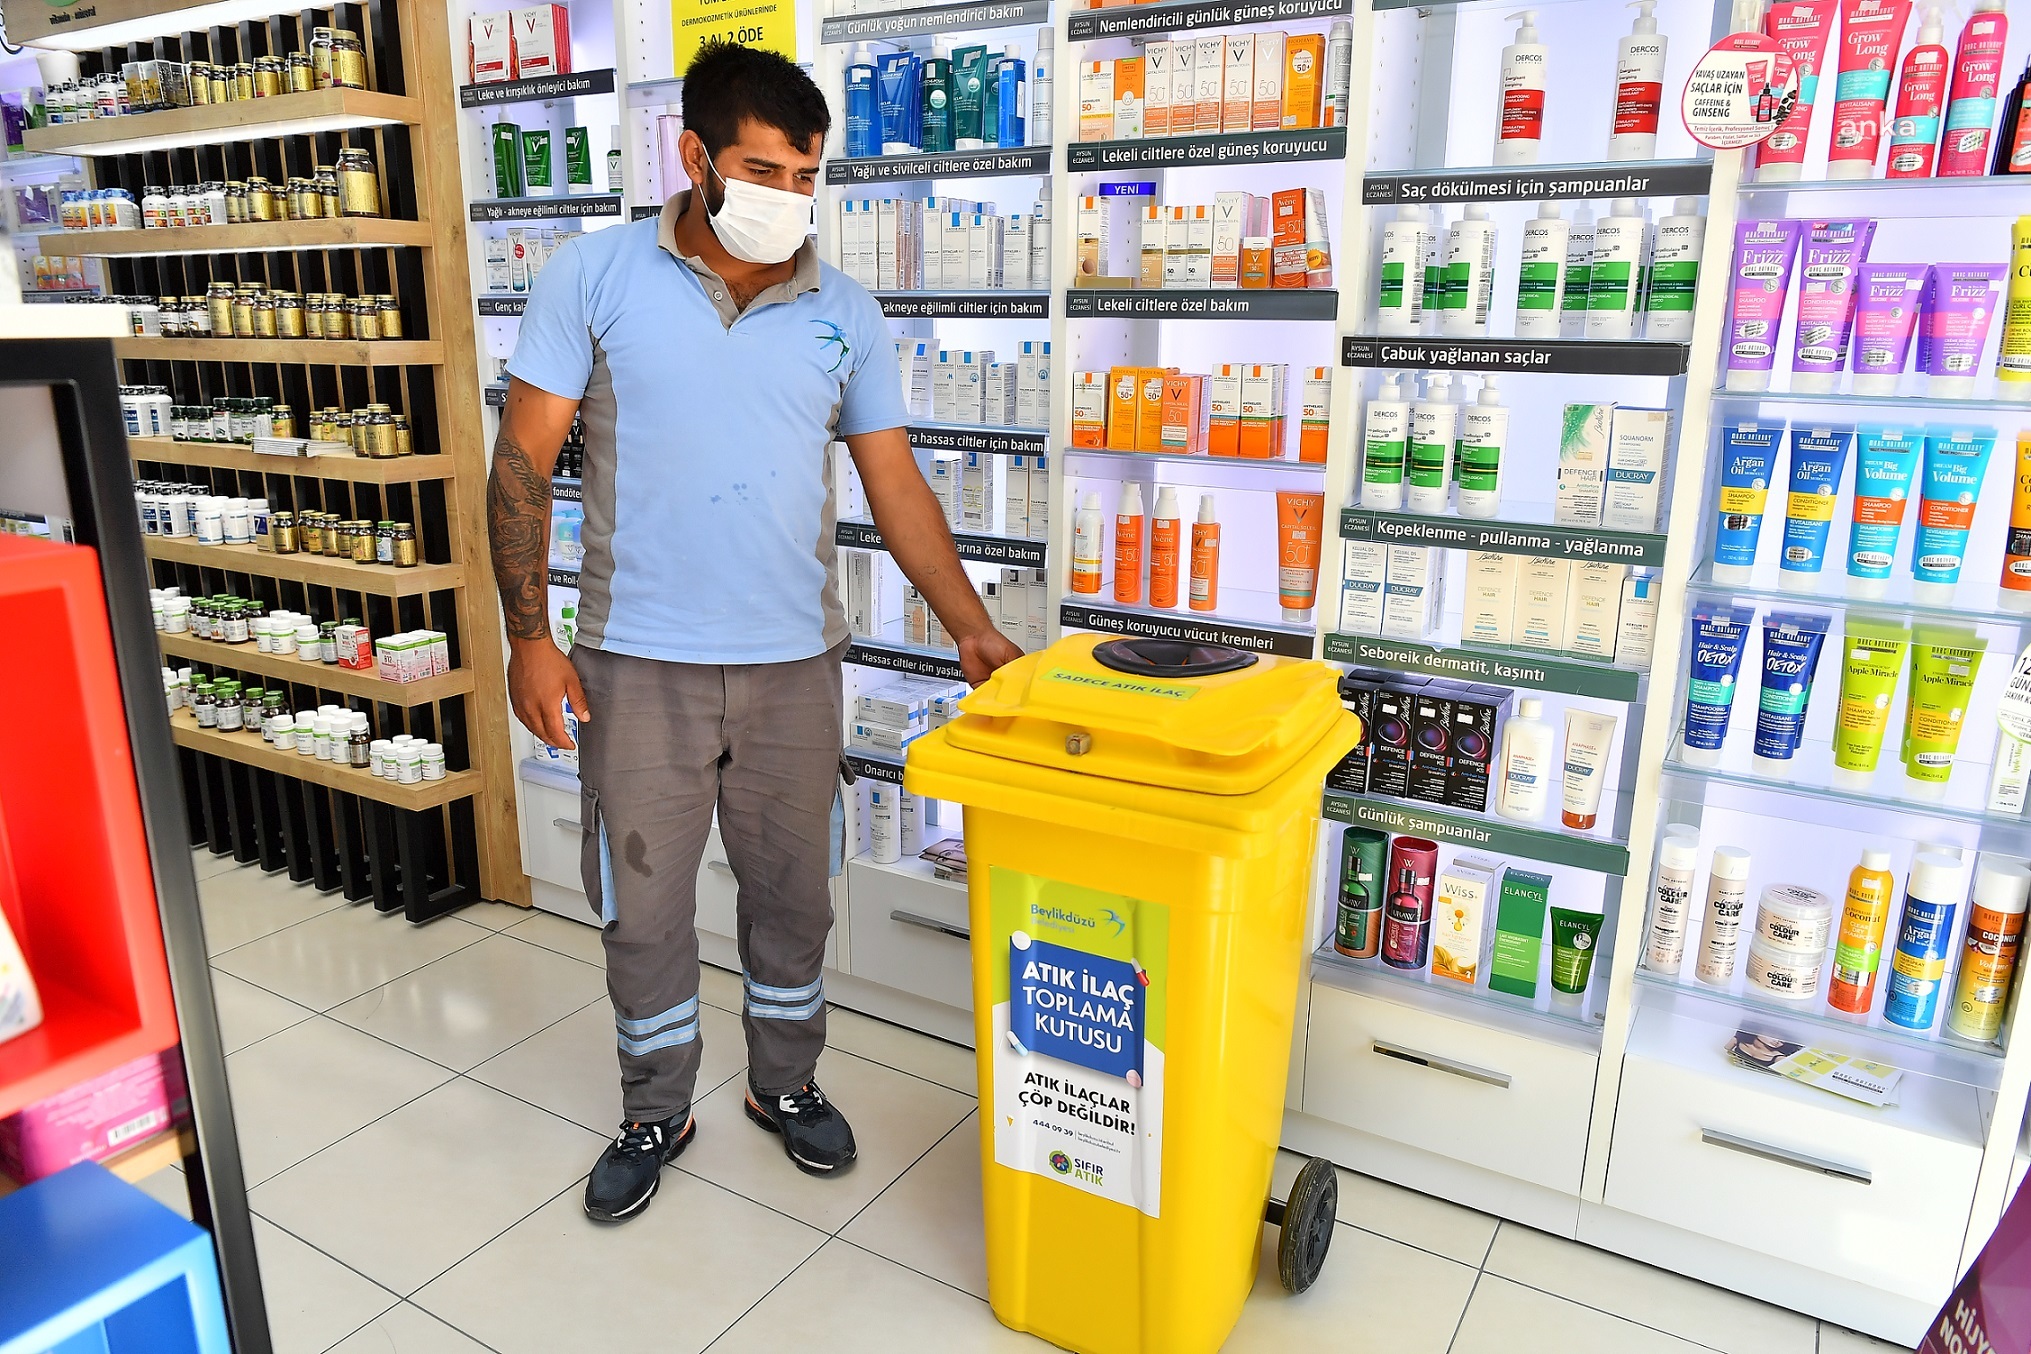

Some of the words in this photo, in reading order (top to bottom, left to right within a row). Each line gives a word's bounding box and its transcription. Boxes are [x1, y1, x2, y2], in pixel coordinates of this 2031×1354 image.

[682, 12, 733, 26] DERMOKOZMETİK
[735, 4, 777, 19] ÜRÜNLERİNDE
[847, 17, 881, 34] Günlük
[885, 17, 916, 31] yoğun
[920, 9, 986, 27] nemlendirici
[989, 5, 1023, 19] bakım
[1100, 12, 1183, 32] Nemlendiricili
[1186, 6, 1230, 28] günlük
[1234, 3, 1274, 22] güneş
[1279, 0, 1342, 16] koruyucu
[738, 26, 763, 43] ÖDE
[1848, 32, 1883, 45] Grow
[1199, 41, 1221, 49] VICHY
[1855, 43, 1888, 57] Long
[1962, 61, 1992, 73] Grow
[1696, 70, 1714, 80] YAVAŞ
[1717, 71, 1745, 79] UZAYAN
[1968, 71, 1996, 84] Long
[478, 89, 494, 101] Leke
[496, 89, 504, 99] ve
[538, 81, 565, 94] önleyici
[567, 79, 590, 90] bakım
[1691, 83, 1721, 95] SAÇLAR
[1724, 83, 1742, 96] İÇİN
[1693, 108, 1730, 117] GINSENG
[1102, 146, 1138, 162] Lekeli
[1141, 146, 1185, 161] ciltlere
[1189, 143, 1214, 158] özel
[1218, 142, 1259, 160] güneş
[1262, 139, 1327, 158] koruyucu
[852, 165, 875, 179] Yağlı
[878, 166, 890, 175] ve
[893, 161, 931, 175] sivilceli
[933, 158, 970, 173] ciltlere
[973, 156, 995, 171] özel
[998, 156, 1031, 168] bakım
[1114, 184, 1140, 195] YENİ
[1370, 183, 1390, 191] AYSUN
[1401, 182, 1426, 200] Saç
[1431, 180, 1515, 197] dökülmesi
[1516, 179, 1545, 198] için
[1549, 176, 1649, 195] şampuanlar
[1366, 190, 1394, 199] ECZANESİ
[487, 207, 502, 218] Yağlı
[508, 206, 532, 217] akneye
[533, 205, 558, 216] eğilimli
[559, 203, 579, 214] ciltler
[581, 202, 593, 215] için
[595, 201, 617, 212] bakım
[1870, 285, 1904, 297] Frizz
[495, 301, 512, 313] Genç
[884, 304, 918, 315] akneye
[920, 302, 956, 316] eğilimli
[959, 302, 987, 314] ciltler
[990, 303, 1008, 316] için
[1011, 302, 1042, 314] bakım
[1098, 298, 1132, 312] Lekeli
[1135, 298, 1178, 312] ciltlere
[1181, 298, 1207, 312] özel
[1210, 299, 1249, 312] bakım
[1381, 347, 1426, 365] Çabuk
[1429, 347, 1500, 368] yağlanan
[1504, 350, 1551, 368] saçlar
[920, 432, 954, 446] hassas
[957, 435, 986, 447] ciltler
[990, 438, 1008, 451] için
[1011, 439, 1044, 452] bakım
[1620, 434, 1654, 443] SQUANORM
[1733, 457, 1764, 468] Argan
[1884, 461, 1898, 471] Big
[1615, 472, 1649, 480] DUCRAY
[1731, 467, 1744, 475] Oil
[1864, 468, 1908, 480] Volume
[1287, 498, 1315, 506] VICHY
[1344, 524, 1369, 532] ECZANESİ
[1348, 517, 1367, 525] AYSUN
[1377, 520, 1466, 543] Kepeklenme
[1479, 531, 1550, 548] pullanma
[1564, 538, 1644, 557] yağlanma
[860, 531, 881, 544] Leke
[985, 545, 1006, 558] özel
[1008, 547, 1040, 561] bakım
[1349, 582, 1376, 590] DUCRAY
[1089, 614, 1124, 631] Güneş
[1127, 619, 1181, 638] koruyucu
[1184, 627, 1219, 643] vücut
[1222, 632, 1274, 650] kremleri
[1721, 644, 1737, 653] Scalp
[862, 652, 891, 666] Hassas
[893, 658, 916, 671] ciltler
[919, 662, 934, 673] için
[1360, 645, 1420, 665] Seboreik
[1423, 655, 1489, 675] dermatit,
[1493, 662, 1545, 682] kaşıntı
[1698, 650, 1736, 664] DETOX
[1848, 665, 1869, 676] Apple
[1870, 668, 1898, 678] Miracle
[1054, 673, 1111, 687] SADECE
[1112, 681, 1147, 692] ATIK
[1151, 687, 1185, 697] İLAÇ
[865, 764, 896, 780] Onarıcı
[1358, 806, 1404, 826] Günlük
[1408, 818, 1491, 843] şampuanlar
[1445, 883, 1474, 899] Wiss
[1504, 887, 1543, 901] ELANCYL
[1030, 903, 1096, 929] Beylikdüzü
[1845, 908, 1881, 924] Coconut
[1560, 920, 1590, 931] ELANCYL
[1769, 923, 1799, 936] COLOUR
[1773, 931, 1793, 941] CARE
[1983, 932, 2016, 943] COCONUT
[1022, 961, 1076, 991] ATIK
[1082, 968, 1134, 1011] İLAÇ
[1022, 985, 1134, 1032] TOPLAMA
[1036, 1011, 1122, 1053] KUTUSU
[1024, 1071, 1060, 1093] ATIK
[1064, 1079, 1130, 1114] İLAÇLAR
[1018, 1091, 1053, 1110] ÇÖP
[1057, 1100, 1135, 1136] DEĞİLDİR!
[1033, 1120, 1050, 1129] 444
[1075, 1159, 1103, 1176] SIFIR
[1075, 1169, 1103, 1186] ATIK
